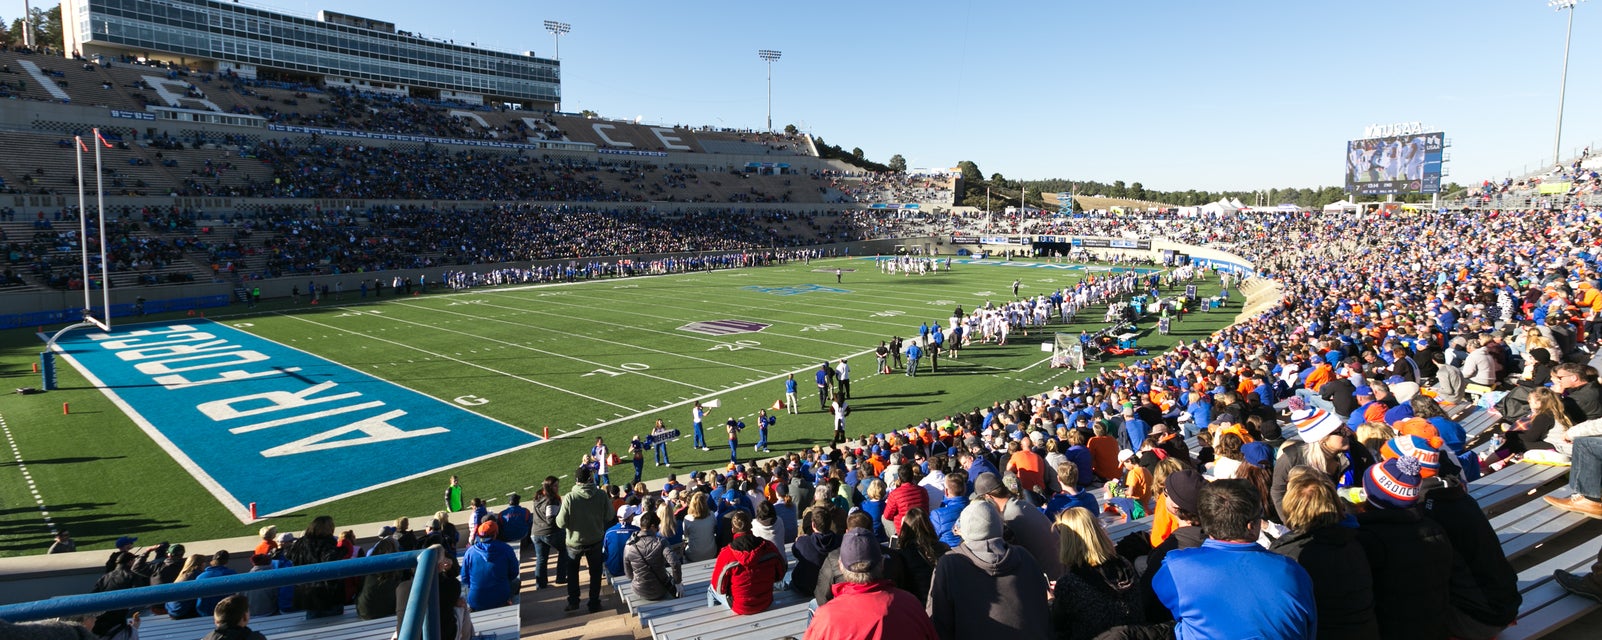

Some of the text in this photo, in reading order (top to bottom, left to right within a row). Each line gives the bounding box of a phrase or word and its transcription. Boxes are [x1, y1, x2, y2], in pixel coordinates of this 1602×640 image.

[86, 324, 303, 390] FORCE
[196, 380, 451, 458] AIR
[453, 394, 490, 406] G
